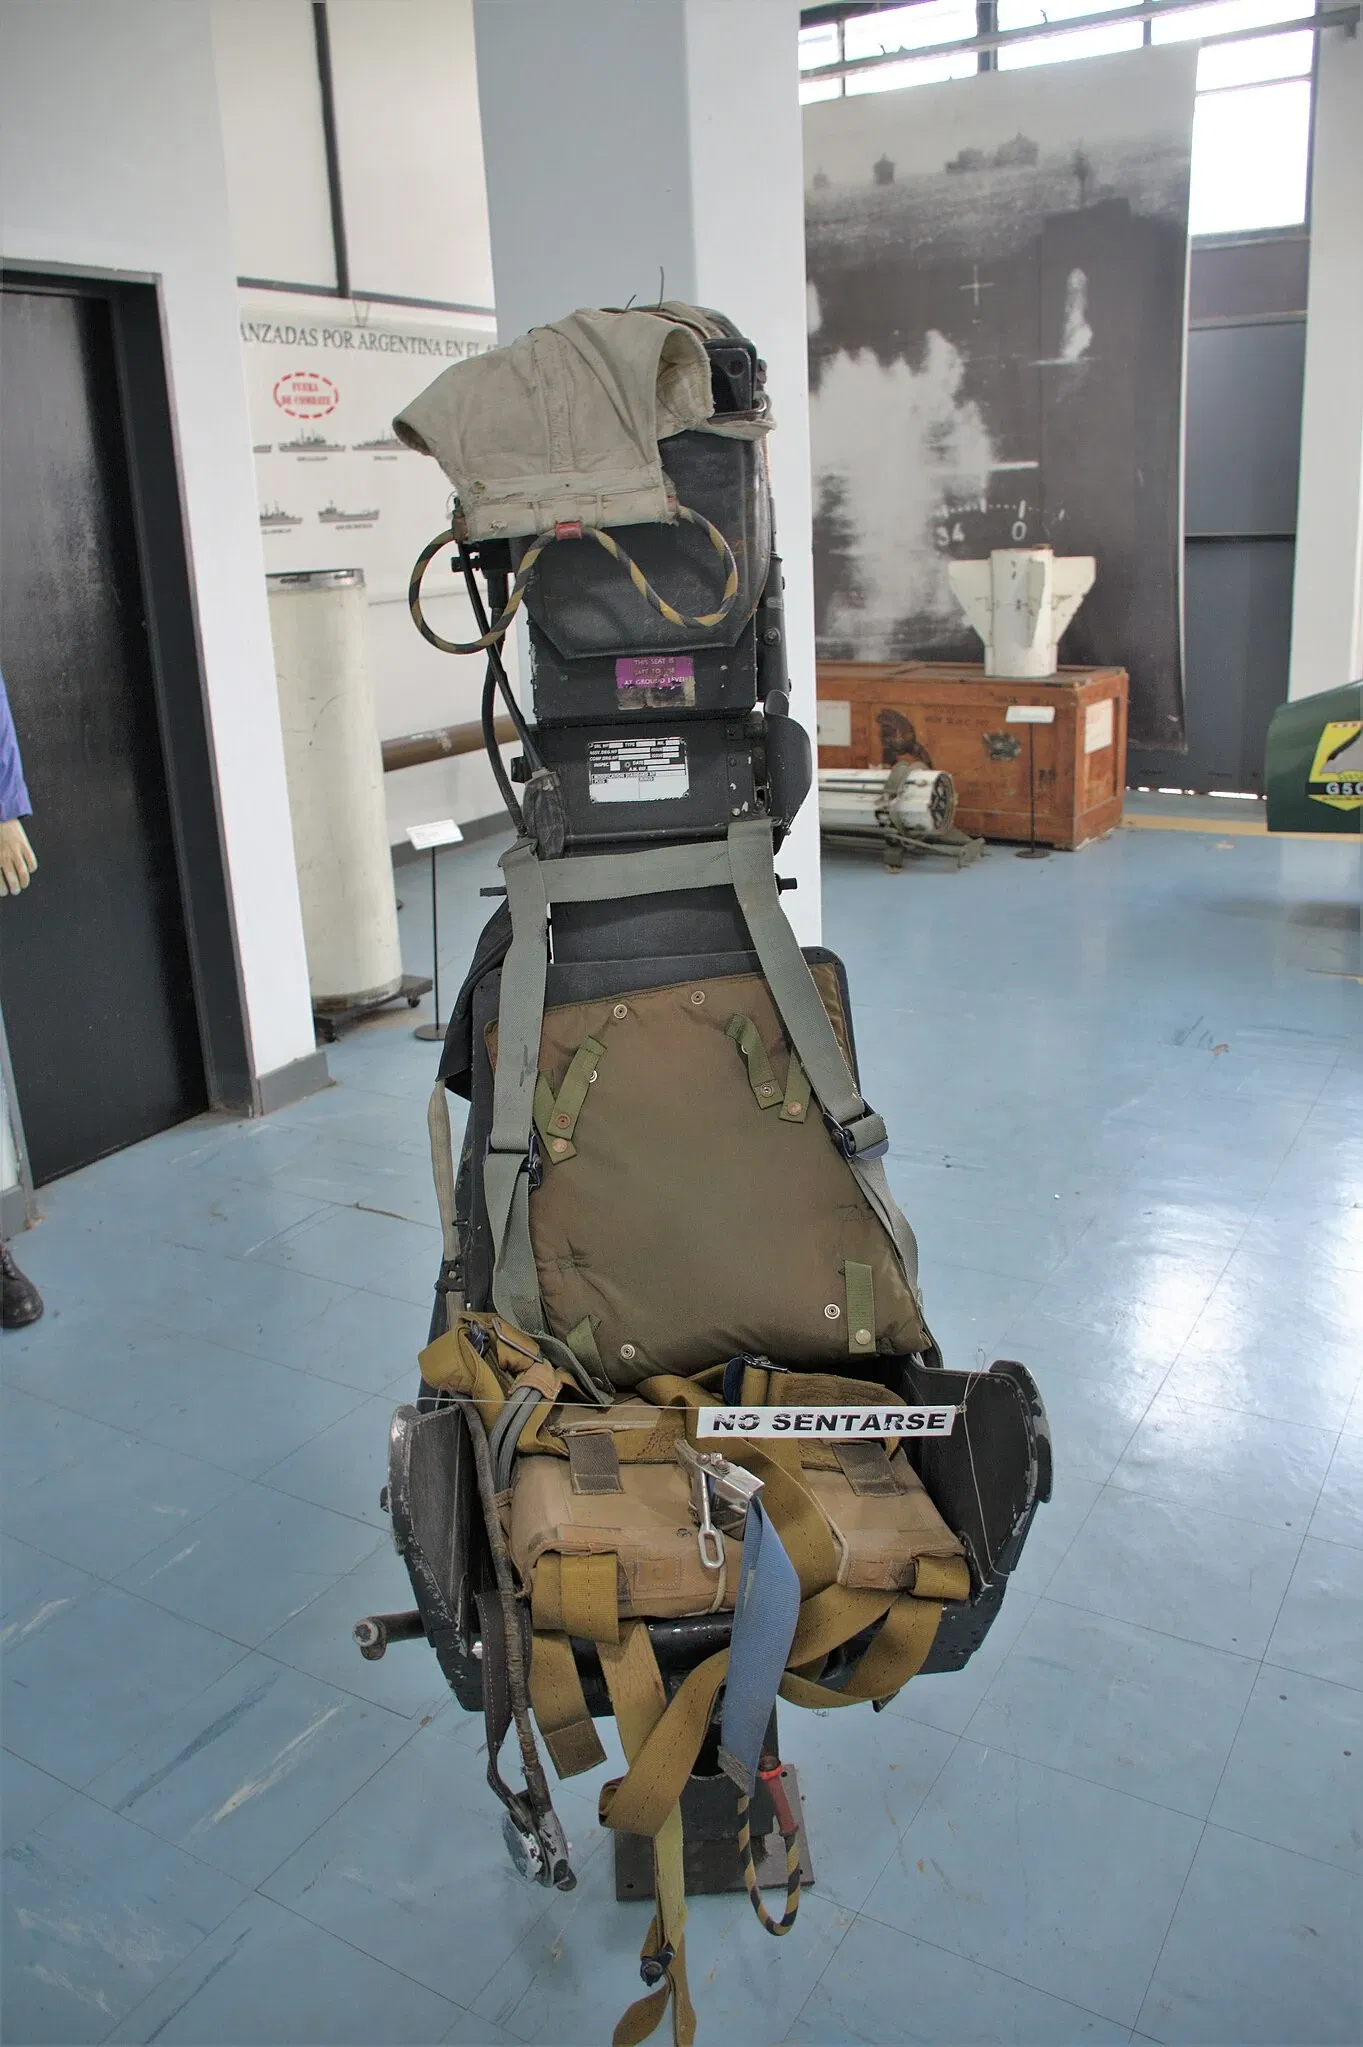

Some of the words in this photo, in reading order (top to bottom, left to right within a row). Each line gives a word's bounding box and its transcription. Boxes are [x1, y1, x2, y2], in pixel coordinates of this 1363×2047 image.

[322, 328, 354, 349] POR
[358, 332, 442, 356] ARGENTINA
[445, 340, 463, 357] EN
[713, 1413, 760, 1431] NO
[772, 1412, 947, 1431] SENTARSE
